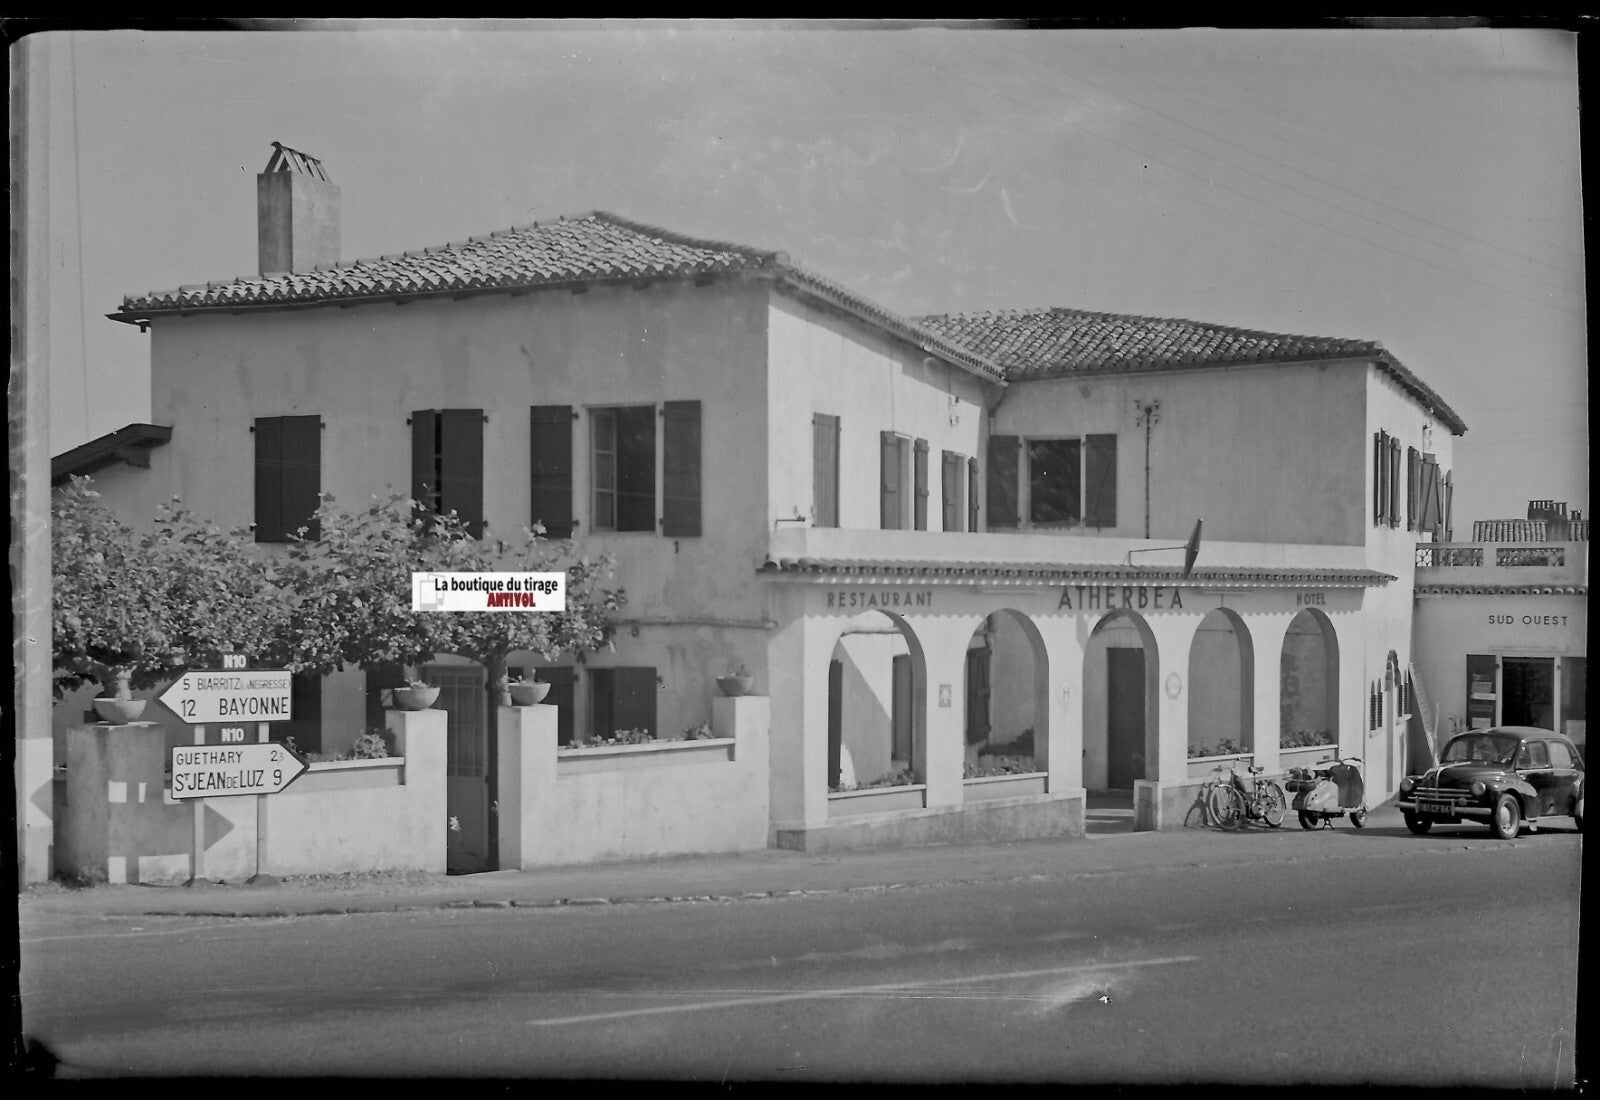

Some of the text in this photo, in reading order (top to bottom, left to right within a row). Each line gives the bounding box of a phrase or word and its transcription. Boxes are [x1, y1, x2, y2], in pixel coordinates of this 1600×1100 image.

[827, 592, 933, 608] RESTAURANT
[1058, 585, 1183, 610] ATHERBEA
[1297, 593, 1326, 605] HOTEL
[1488, 615, 1568, 626] SUD OUEST
[223, 654, 246, 668] N10
[183, 678, 190, 690] 5
[180, 696, 288, 716] 12 BAYONNE
[222, 728, 244, 742] N10
[176, 751, 244, 765] GUETHARY
[188, 772, 226, 790] JEAN
[240, 770, 264, 788] LUZ
[273, 769, 282, 786] 9
